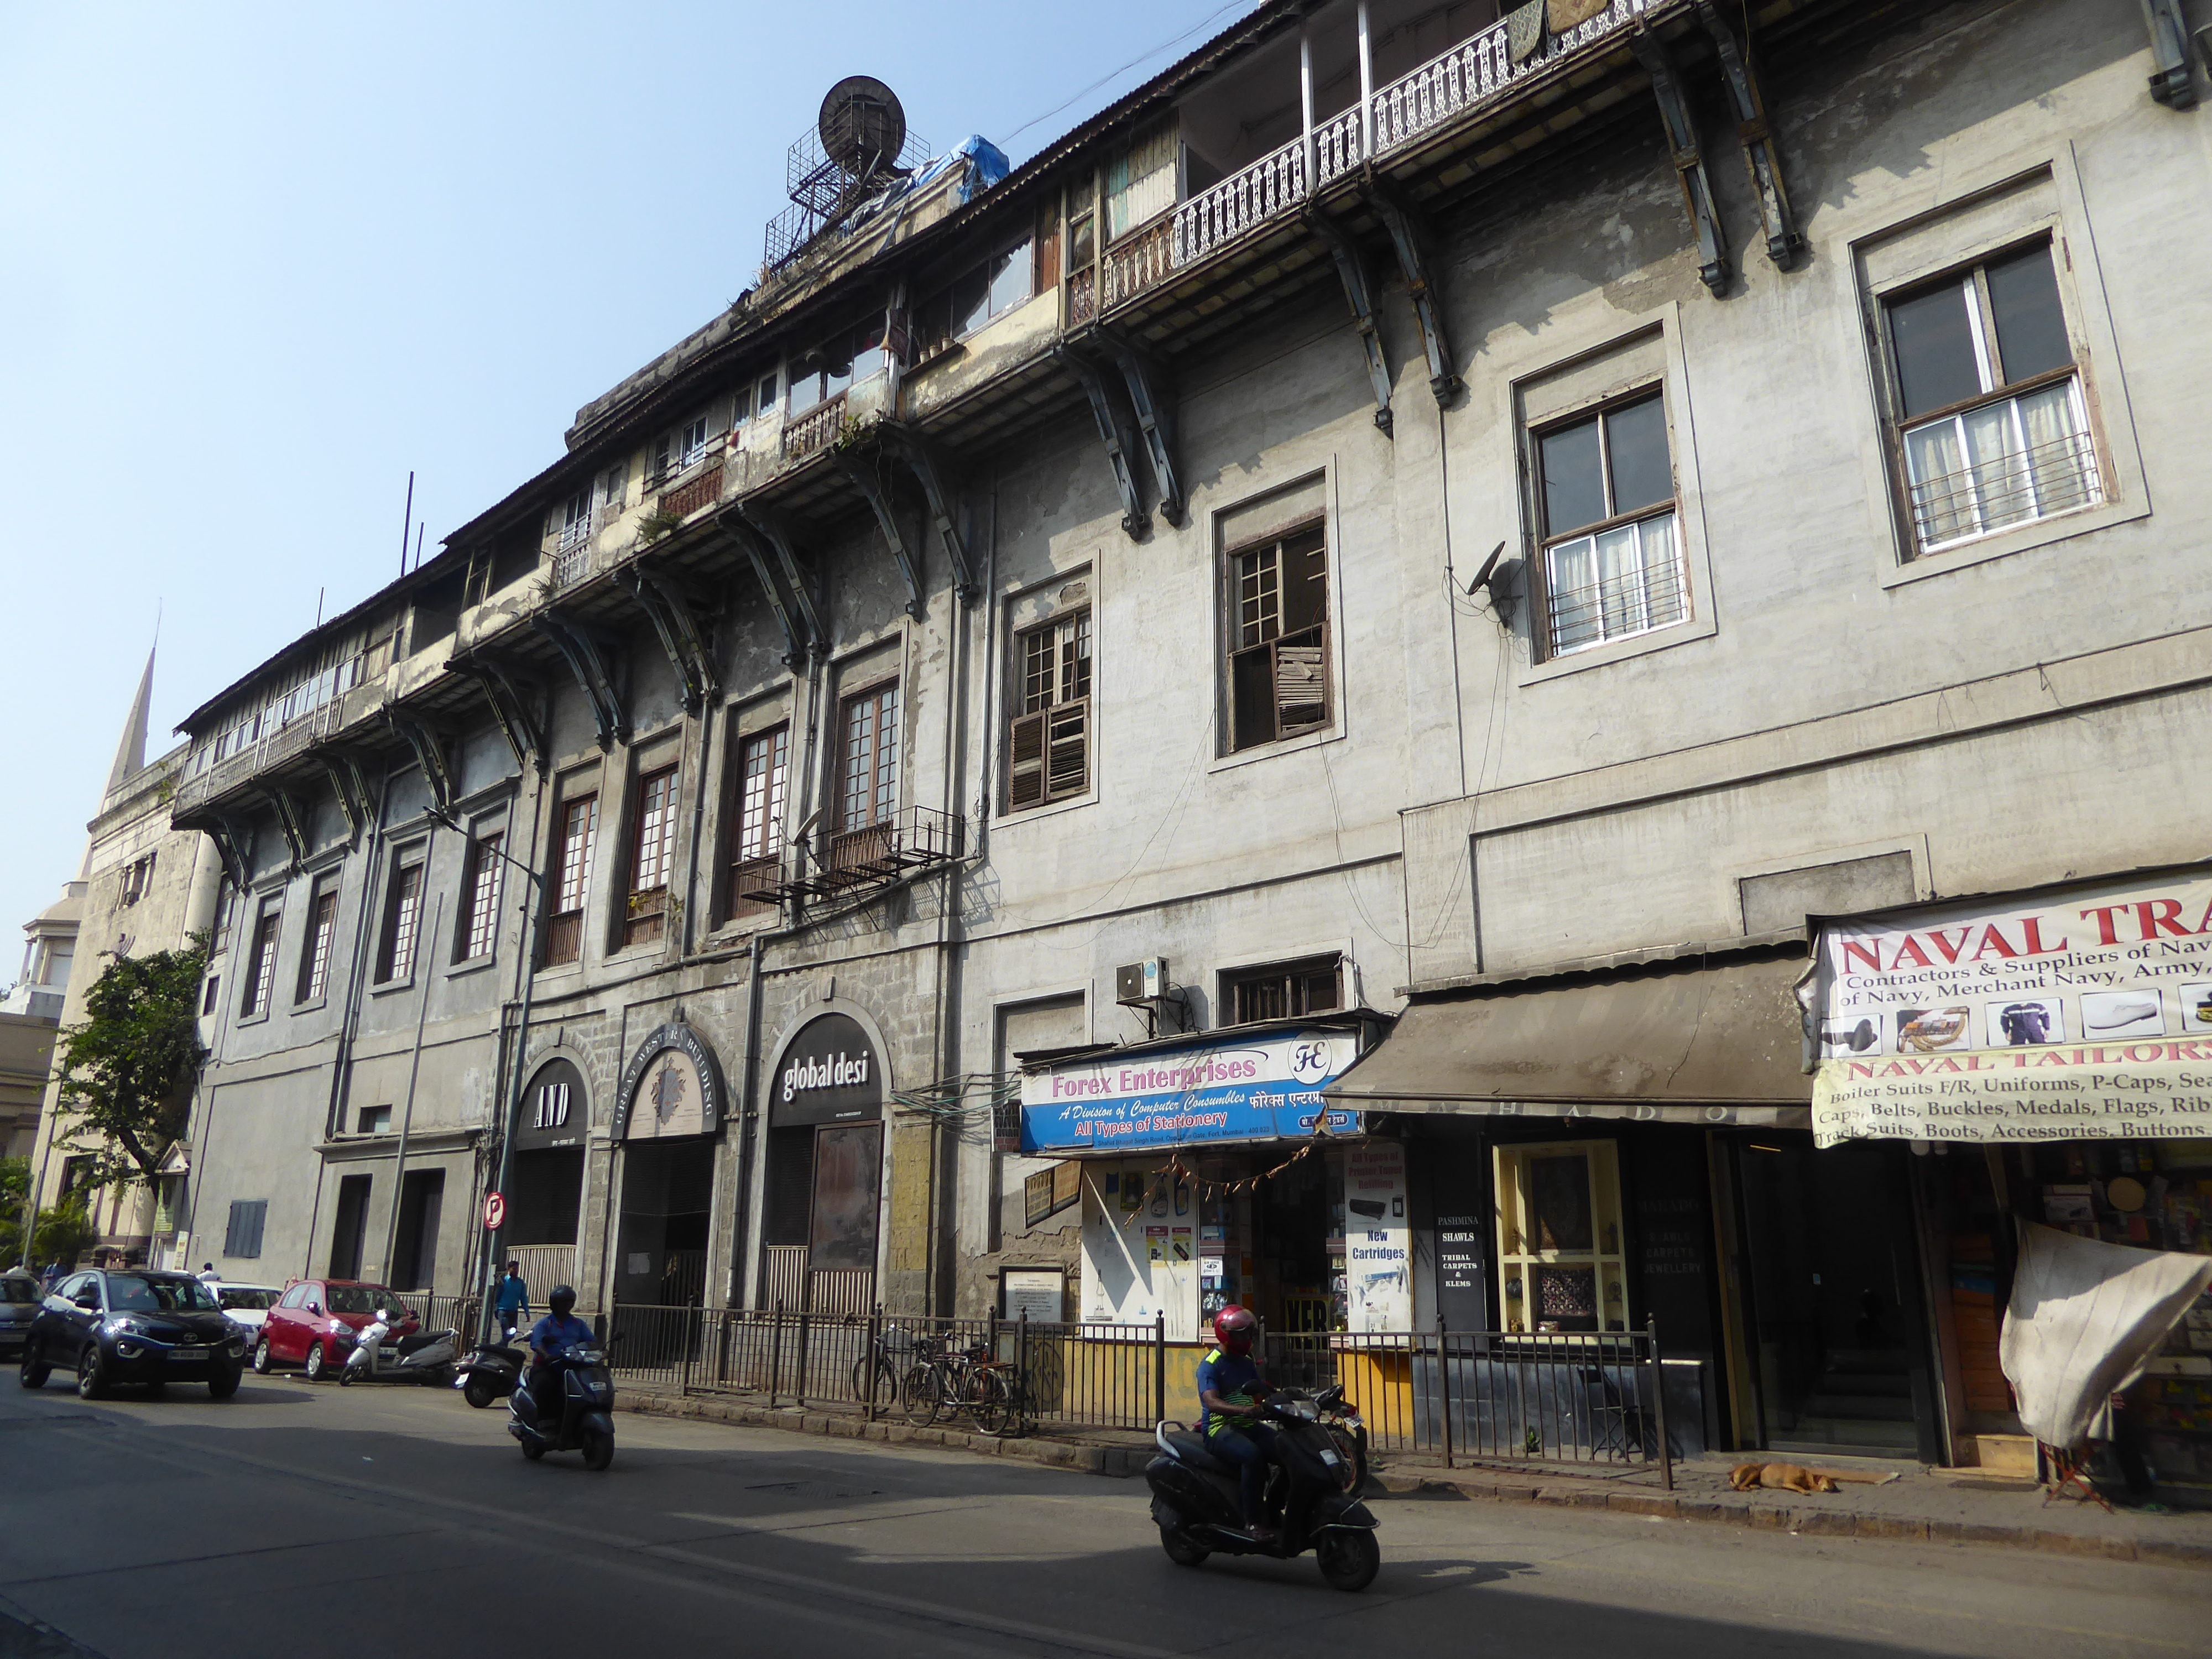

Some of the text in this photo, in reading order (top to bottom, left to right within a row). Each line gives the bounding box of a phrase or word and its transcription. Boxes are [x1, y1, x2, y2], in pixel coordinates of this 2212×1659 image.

[1840, 916, 2067, 975] NAVAL
[1846, 967, 1970, 989] Contractors
[1979, 963, 1997, 975] &
[2005, 952, 2119, 974] Suppliers
[2127, 943, 2151, 959] of
[1840, 961, 2212, 1006] of Navy, Merchant Navy, Army,
[687, 1038, 712, 1115] BUILDING
[1052, 1059, 1256, 1097] Forex Enterprises
[1845, 1056, 1996, 1082] NAVAL
[1249, 1090, 1285, 1109] फोरेक्स
[1830, 1087, 1880, 1104] Boiler
[1887, 1082, 1933, 1096] Suits
[1940, 1079, 1978, 1097] F/R,
[1984, 1077, 2086, 1093] Uniforms,
[2091, 1073, 2172, 1094] P-Caps,
[533, 1083, 568, 1128] AND
[1059, 1089, 1246, 1120] A Division of Computer Consumbles
[1819, 1108, 1865, 1124] Caps,
[1871, 1103, 1922, 1118] Belts,
[1927, 1100, 2010, 1117] Buckles,
[2015, 1099, 2097, 1117] Medals,
[2103, 1097, 2164, 1118] Flags,
[1075, 1112, 1228, 1138] All Types of Stationery
[1817, 1126, 1860, 1146] Track
[1866, 1121, 1919, 1138] Suits,
[1925, 1123, 1984, 1140] Boots,
[1352, 1151, 1398, 1162] All Types of
[1349, 1165, 1402, 1177] Printer Toner
[1359, 1180, 1394, 1190] Refilling
[1438, 1216, 1479, 1225] PASHMINA
[1367, 1229, 1387, 1242] New
[1442, 1233, 1474, 1242] SHAWLS
[1353, 1246, 1405, 1260] Cartridges
[1646, 1247, 1695, 1258] CARPETS
[1644, 1262, 1701, 1274] JEWELLERY
